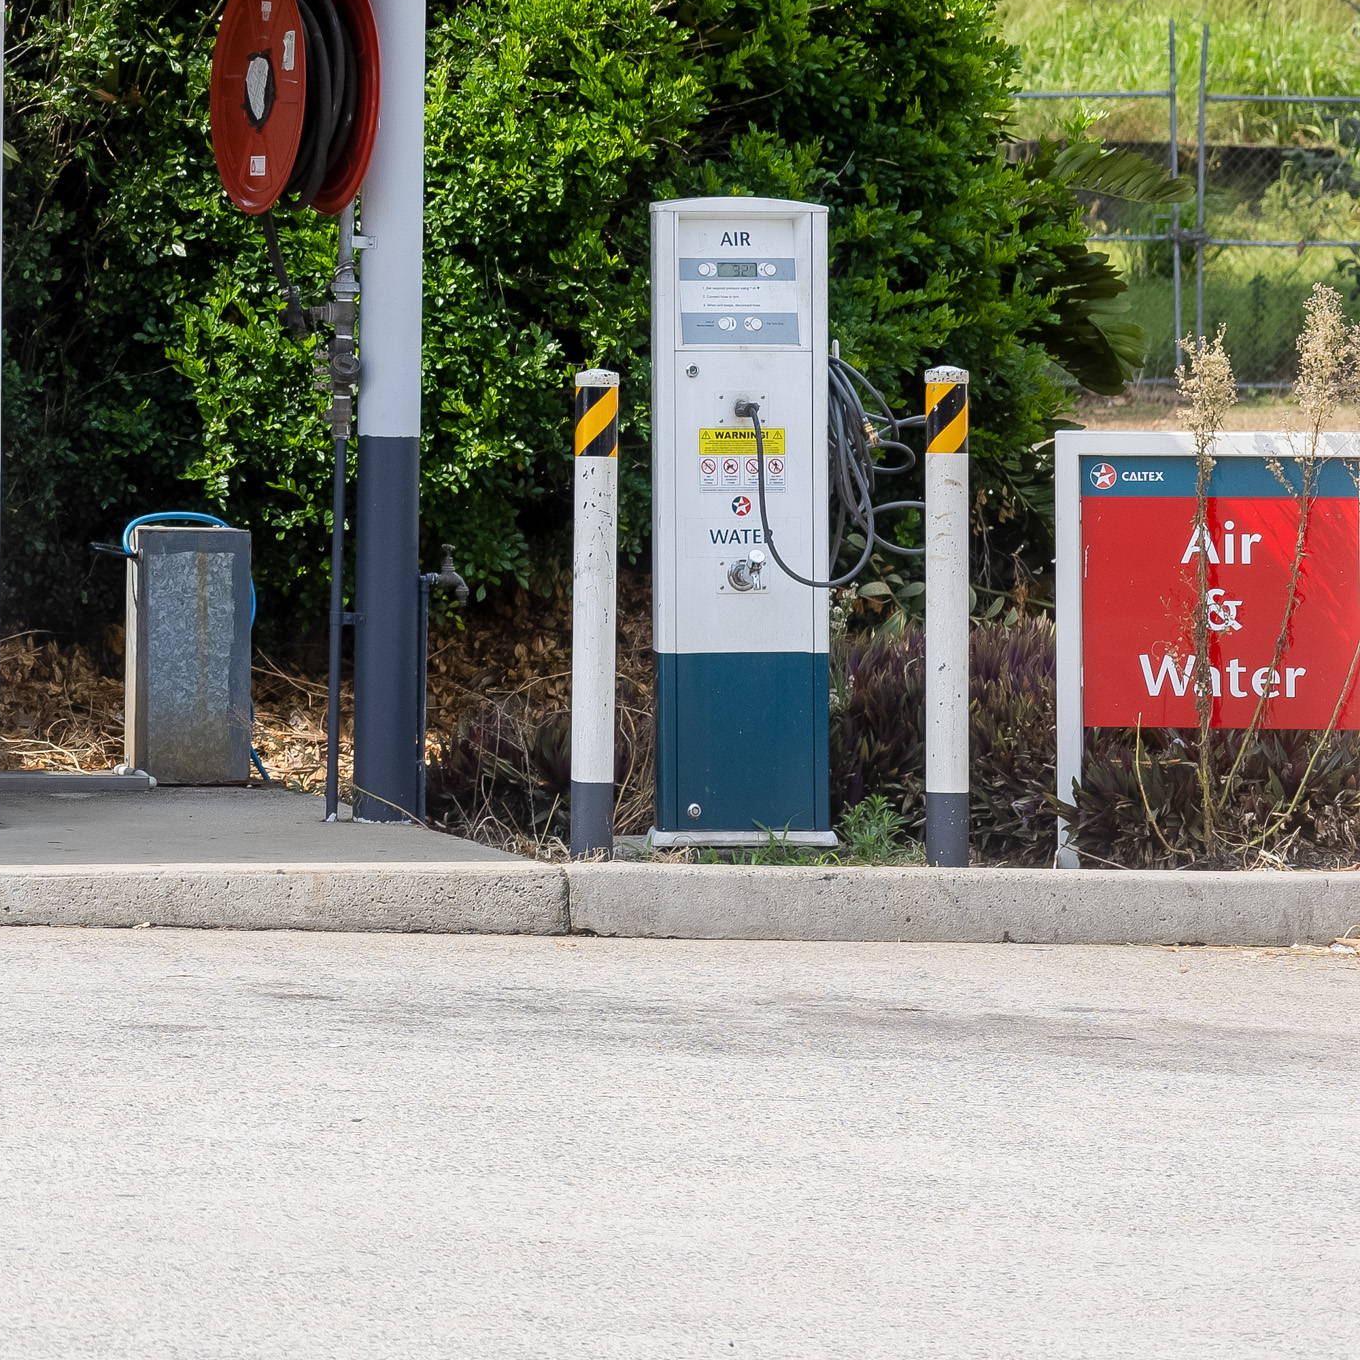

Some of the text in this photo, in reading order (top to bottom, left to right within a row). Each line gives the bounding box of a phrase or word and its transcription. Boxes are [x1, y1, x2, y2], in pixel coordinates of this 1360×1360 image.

[720, 231, 751, 246] AIR
[714, 431, 769, 439] WARNING!
[1121, 471, 1165, 482] CALTEX
[1181, 520, 1263, 565] Air
[1203, 588, 1243, 631] &
